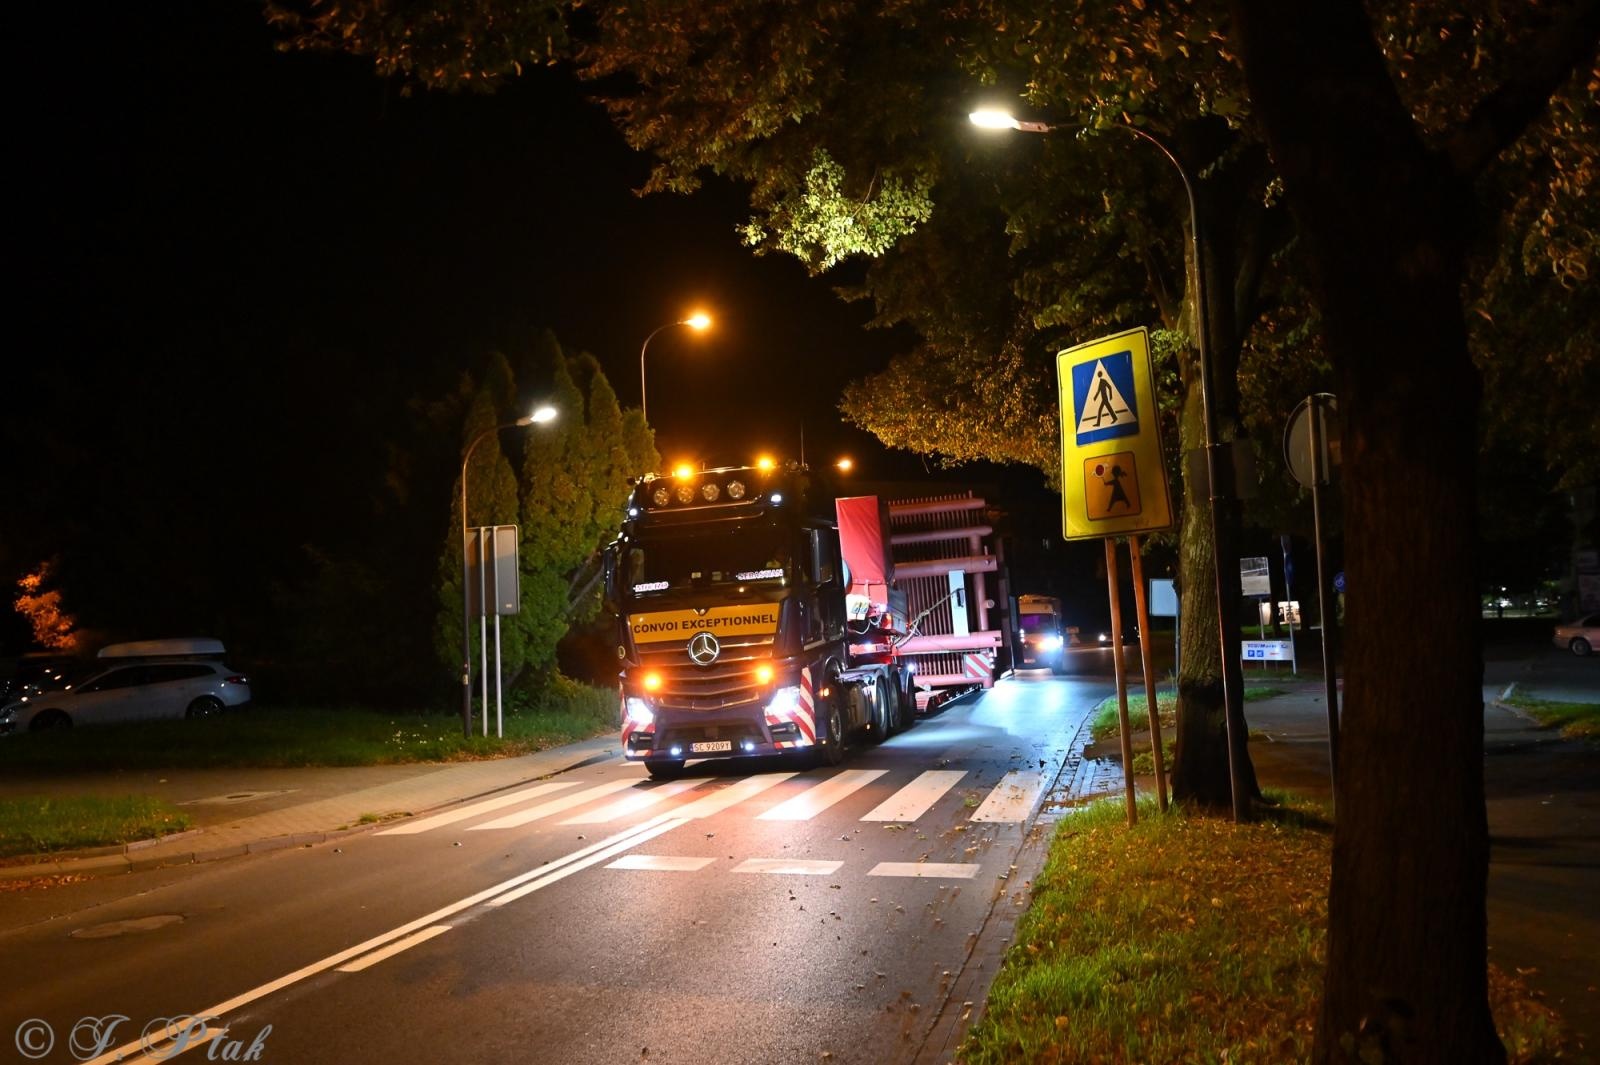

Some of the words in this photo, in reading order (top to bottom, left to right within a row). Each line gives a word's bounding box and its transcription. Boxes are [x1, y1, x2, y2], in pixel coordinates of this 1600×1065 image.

[634, 621, 678, 634] CONVOI
[682, 614, 777, 630] EXCEPTIONNEL
[694, 743, 704, 751] SC
